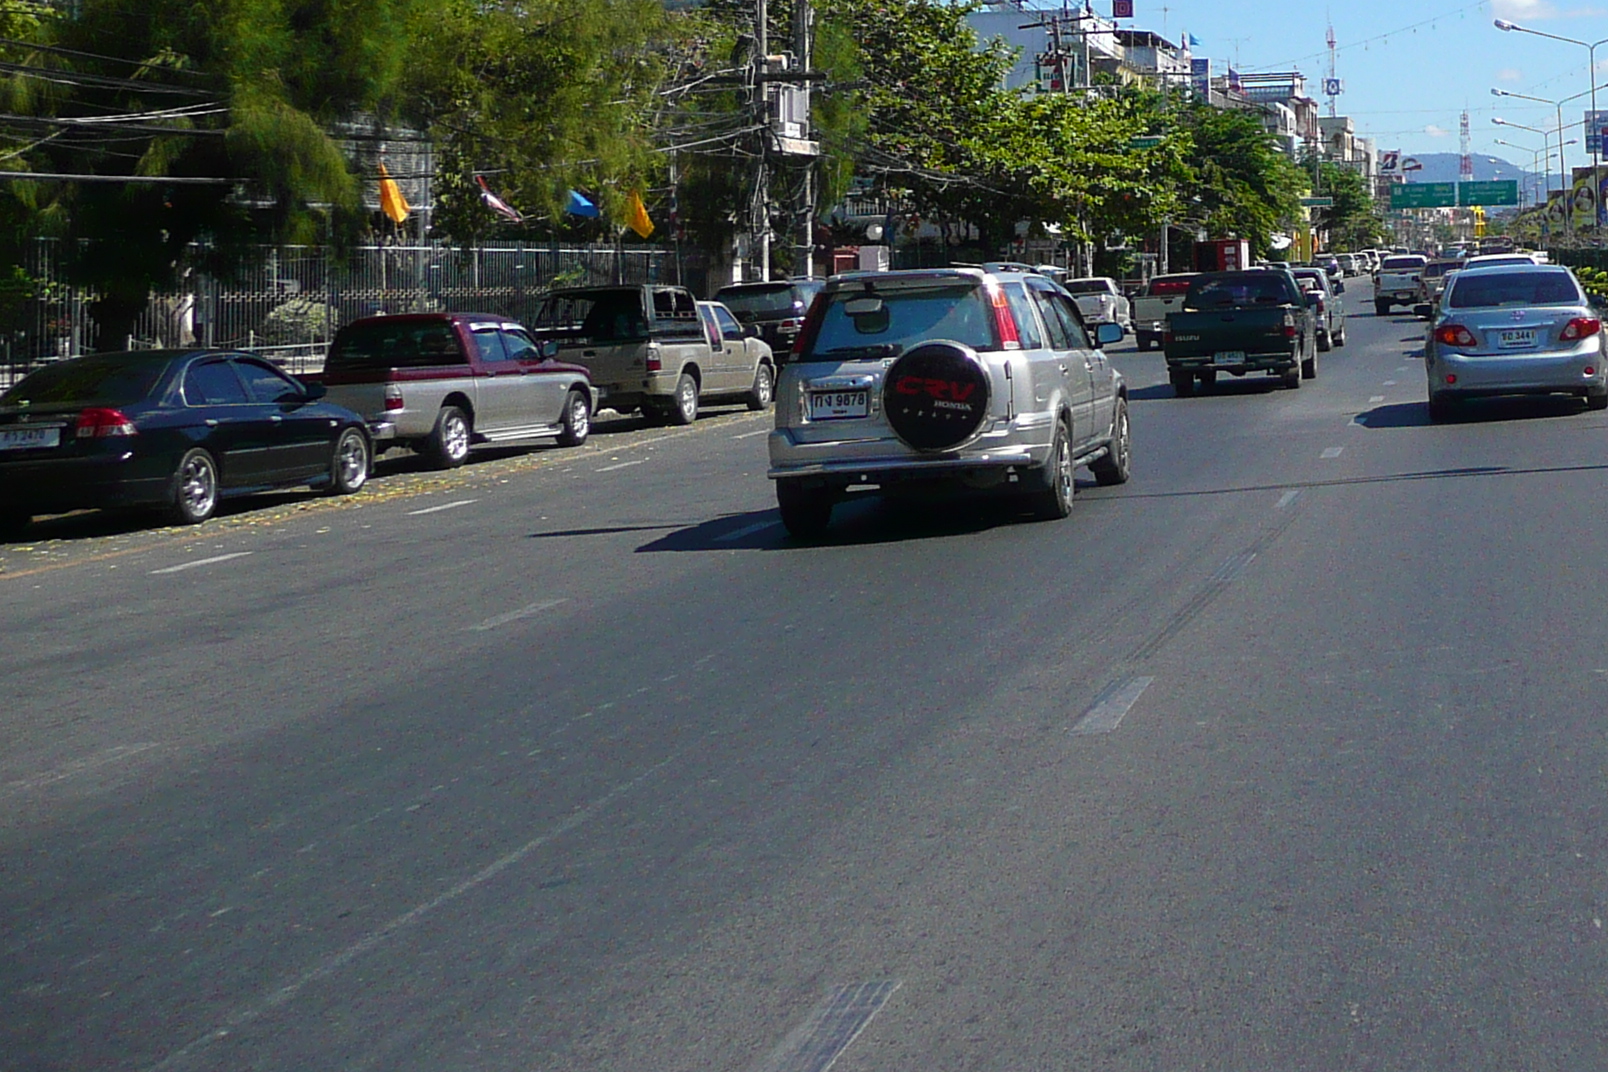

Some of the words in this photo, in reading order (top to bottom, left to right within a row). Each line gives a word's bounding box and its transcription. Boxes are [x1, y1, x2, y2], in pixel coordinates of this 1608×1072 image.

[896, 375, 976, 401] CRV
[836, 393, 865, 406] 9878
[933, 399, 973, 411] HONDA
